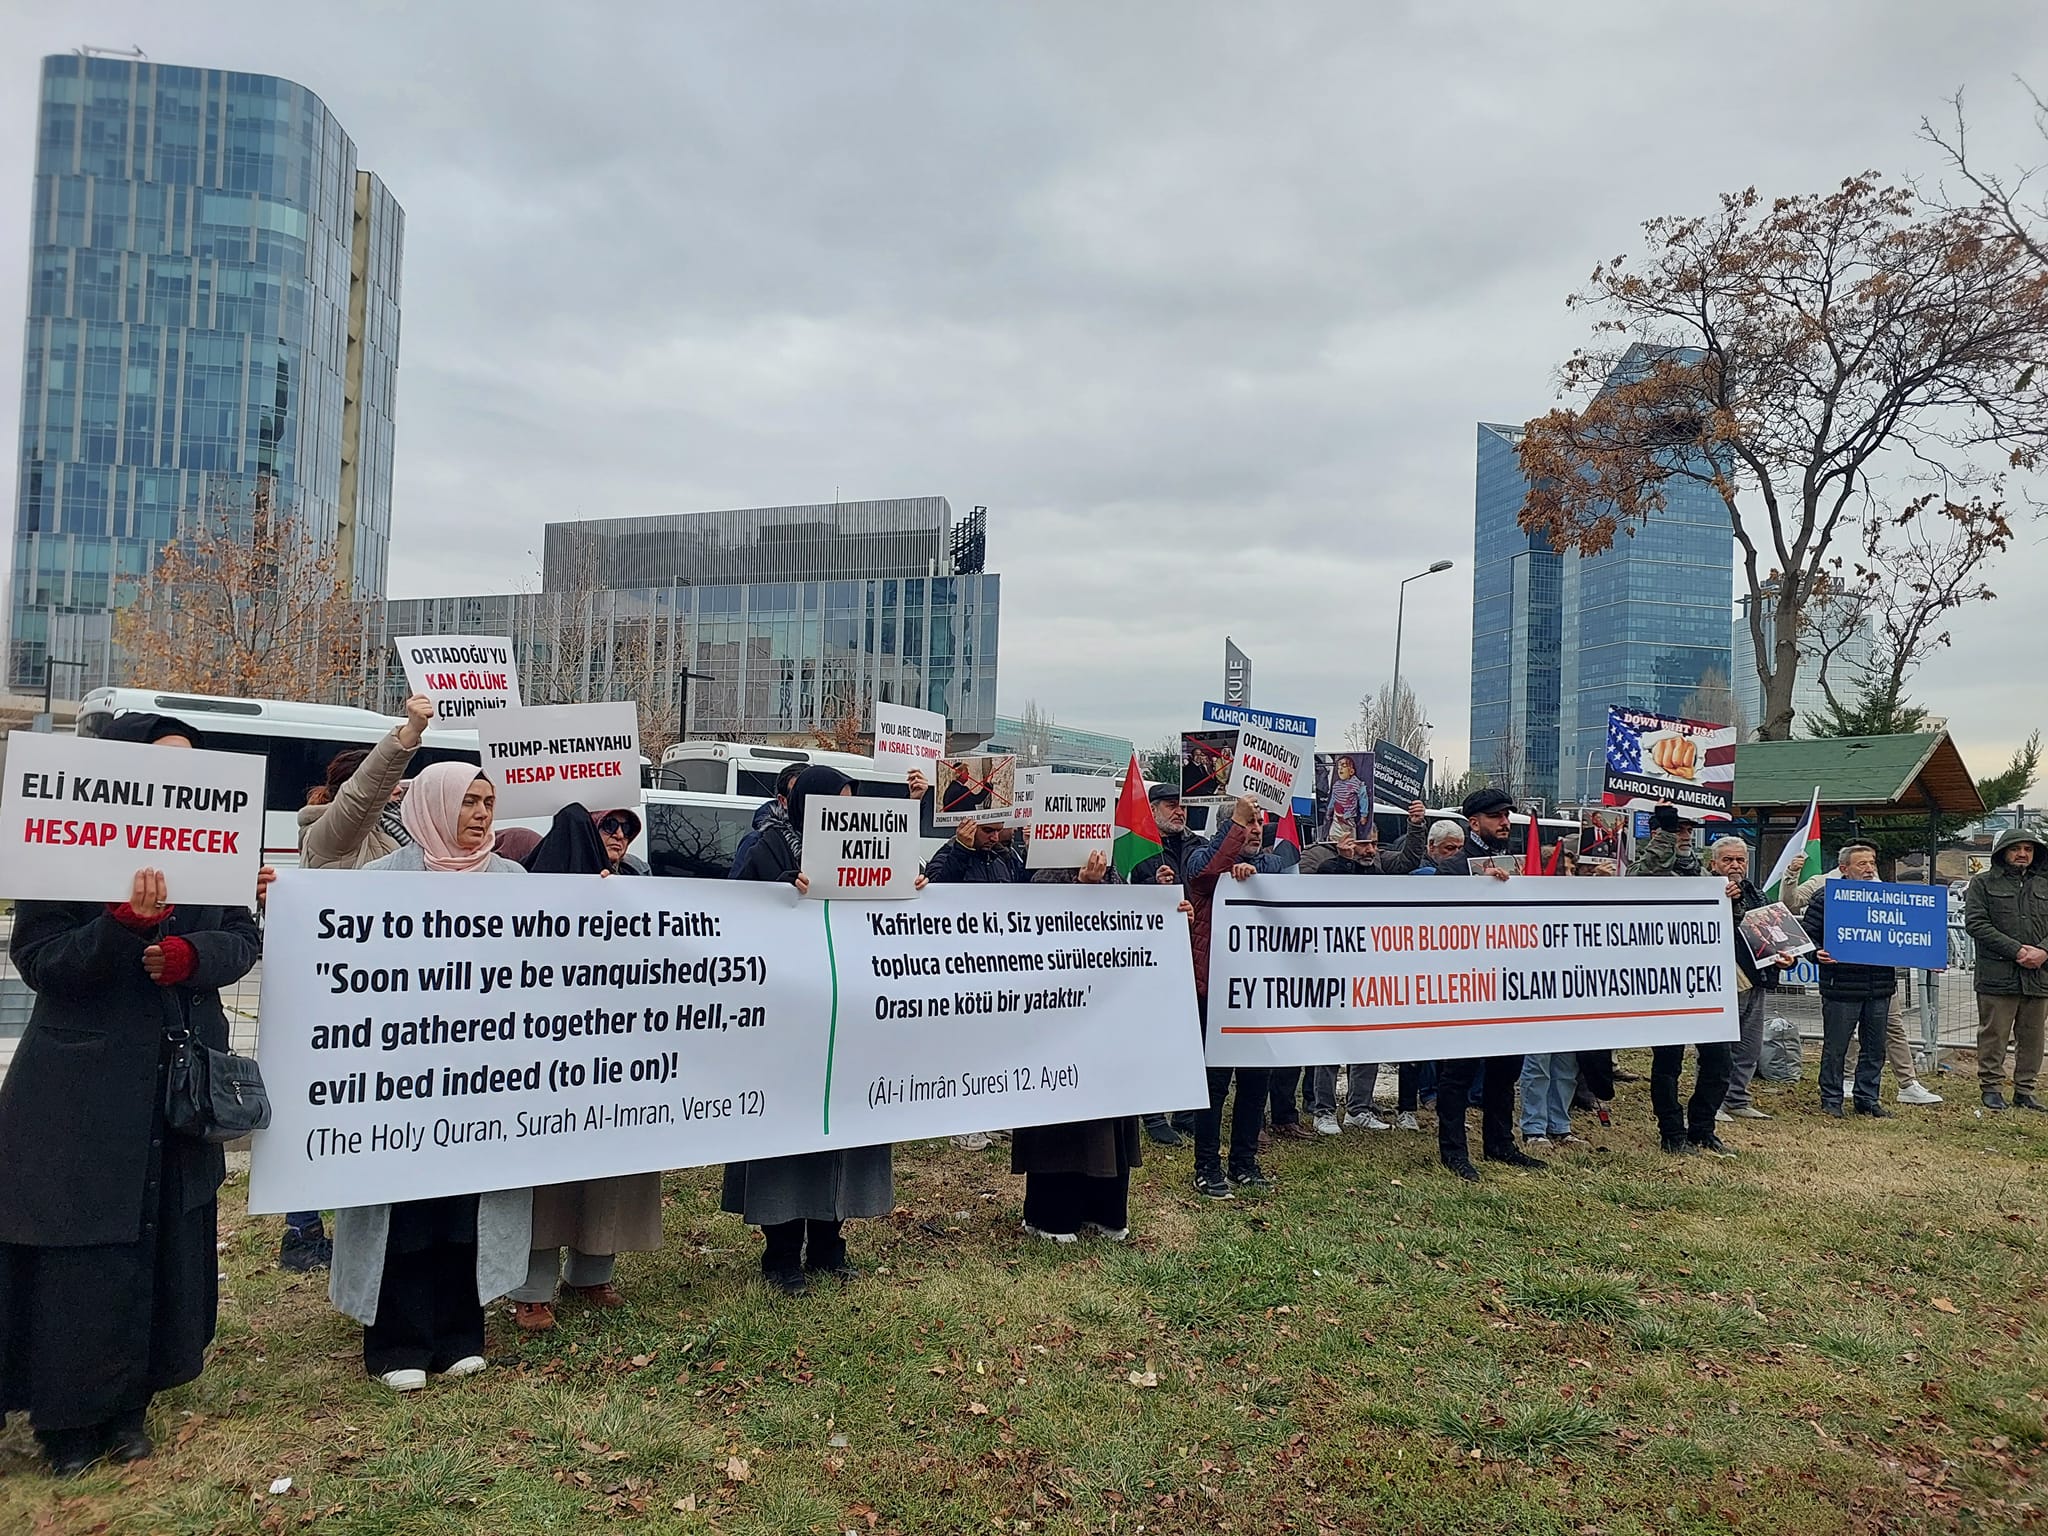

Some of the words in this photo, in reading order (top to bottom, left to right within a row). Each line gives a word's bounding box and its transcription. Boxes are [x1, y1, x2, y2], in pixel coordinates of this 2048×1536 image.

[411, 644, 507, 665] ORTADOĞU'YU
[426, 674, 457, 690] KAN
[460, 670, 508, 690] GÖLÜNE
[881, 722, 895, 735] YOU
[897, 725, 911, 737] ARE
[913, 728, 942, 744] COMPLICIT
[1624, 713, 1658, 728] DOWN
[1661, 720, 1690, 733] WIHT
[1693, 727, 1714, 737] USA
[489, 735, 632, 758] TRUMP-NETANYAHU
[879, 740, 887, 751] IN
[889, 741, 920, 756] ISRAEL'S
[1243, 732, 1299, 768] ORTADOĞU'YU
[505, 764, 555, 785] HESAP
[559, 761, 622, 780] VERECEK
[1243, 754, 1263, 772] KAN
[1264, 762, 1292, 787] GÖLÜNE
[22, 771, 65, 800] ELİ
[72, 776, 154, 806] KANLI
[162, 784, 248, 813] TRUMP
[1015, 791, 1024, 802] THE
[1243, 775, 1285, 805] ÇEVİRDİNİZ
[1609, 777, 1674, 799] KAHROLSUN
[1677, 790, 1726, 808] AMERİKA
[1015, 808, 1022, 818] OF
[1045, 794, 1072, 812] KATİL
[1076, 797, 1106, 812] TRUMP
[821, 807, 907, 832] İNSANLIĞIN
[1035, 824, 1070, 839] HESAP
[1073, 824, 1111, 839] VERECEK
[24, 818, 117, 847] HESAP
[126, 825, 239, 854] VERECEK
[842, 837, 889, 859] KATİLİ
[837, 867, 891, 886] TRUMP
[1834, 888, 1935, 907] AMERİKA-İNGİLTERE
[318, 908, 373, 942] Say
[383, 909, 413, 939] to
[422, 908, 503, 939] those
[512, 909, 571, 938] who
[577, 910, 651, 941] reject
[658, 909, 721, 938] Faith:
[867, 911, 951, 936] 'Kafirlere
[957, 911, 978, 934] de
[983, 911, 1004, 936] ki,
[1008, 911, 1031, 933] Siz
[1036, 910, 1143, 935] yenileceksiniz
[1147, 912, 1164, 930] ve
[1868, 907, 1906, 925] İSRAİL
[1228, 926, 1240, 953] O
[1246, 925, 1318, 953] TRUMP!
[1323, 926, 1367, 953] TAKE
[1370, 925, 1414, 953] YOUR
[1419, 925, 1480, 951] BLOODY
[1486, 924, 1538, 949] HANDS
[1543, 923, 1568, 948] OFF
[1573, 922, 1601, 947] THE
[1605, 921, 1664, 946] ISLAMIC
[1668, 921, 1721, 945] WORLD!
[1838, 927, 1881, 943] ŞEYTAN
[1888, 929, 1931, 947] ÜÇGENİ
[316, 961, 409, 994] "Soon
[418, 961, 471, 991] will
[479, 964, 513, 994] ye
[520, 960, 553, 988] be
[561, 955, 766, 989] vanquished(351)
[872, 952, 940, 979] topluca
[945, 952, 1044, 975] cehenneme
[1048, 947, 1158, 971] sürüleceksiniz.
[1228, 977, 1258, 1009] EY
[1263, 976, 1346, 1008] TRUMP!
[1352, 974, 1411, 1007] KANLI
[1416, 966, 1496, 1004] ELLERİNİ
[1502, 967, 1557, 1002] İSLAM
[1562, 965, 1682, 998] DÜNYASINDAN
[1686, 965, 1722, 998] ÇEK!
[875, 995, 922, 1020] Orası
[928, 996, 949, 1016] ne
[954, 991, 992, 1015] kötü
[998, 989, 1020, 1012] bir
[1024, 986, 1091, 1014] yataktır.'
[311, 1017, 372, 1050] and
[380, 1012, 515, 1052] gathered
[522, 1007, 636, 1041] together
[643, 1006, 669, 1031] to
[675, 1004, 766, 1036] Hell,-an
[308, 1073, 366, 1106] evil
[376, 1067, 433, 1102] bed
[442, 1059, 541, 1096] indeed
[548, 1059, 585, 1093] (to
[593, 1056, 622, 1085] lie
[630, 1053, 678, 1083] on)!
[868, 1076, 905, 1109] (Âl-i
[910, 1075, 956, 1100] İmrân
[962, 1070, 1008, 1097] Suresi
[1013, 1068, 1036, 1092] 12.
[1041, 1064, 1079, 1090] Ayet)
[306, 1127, 361, 1162] (The
[371, 1121, 424, 1155] Holy
[433, 1115, 508, 1147] Quran,
[516, 1106, 576, 1139] Surah
[584, 1101, 675, 1132] Al-Imran,
[682, 1093, 732, 1120] Verse
[738, 1090, 765, 1118] 12)
